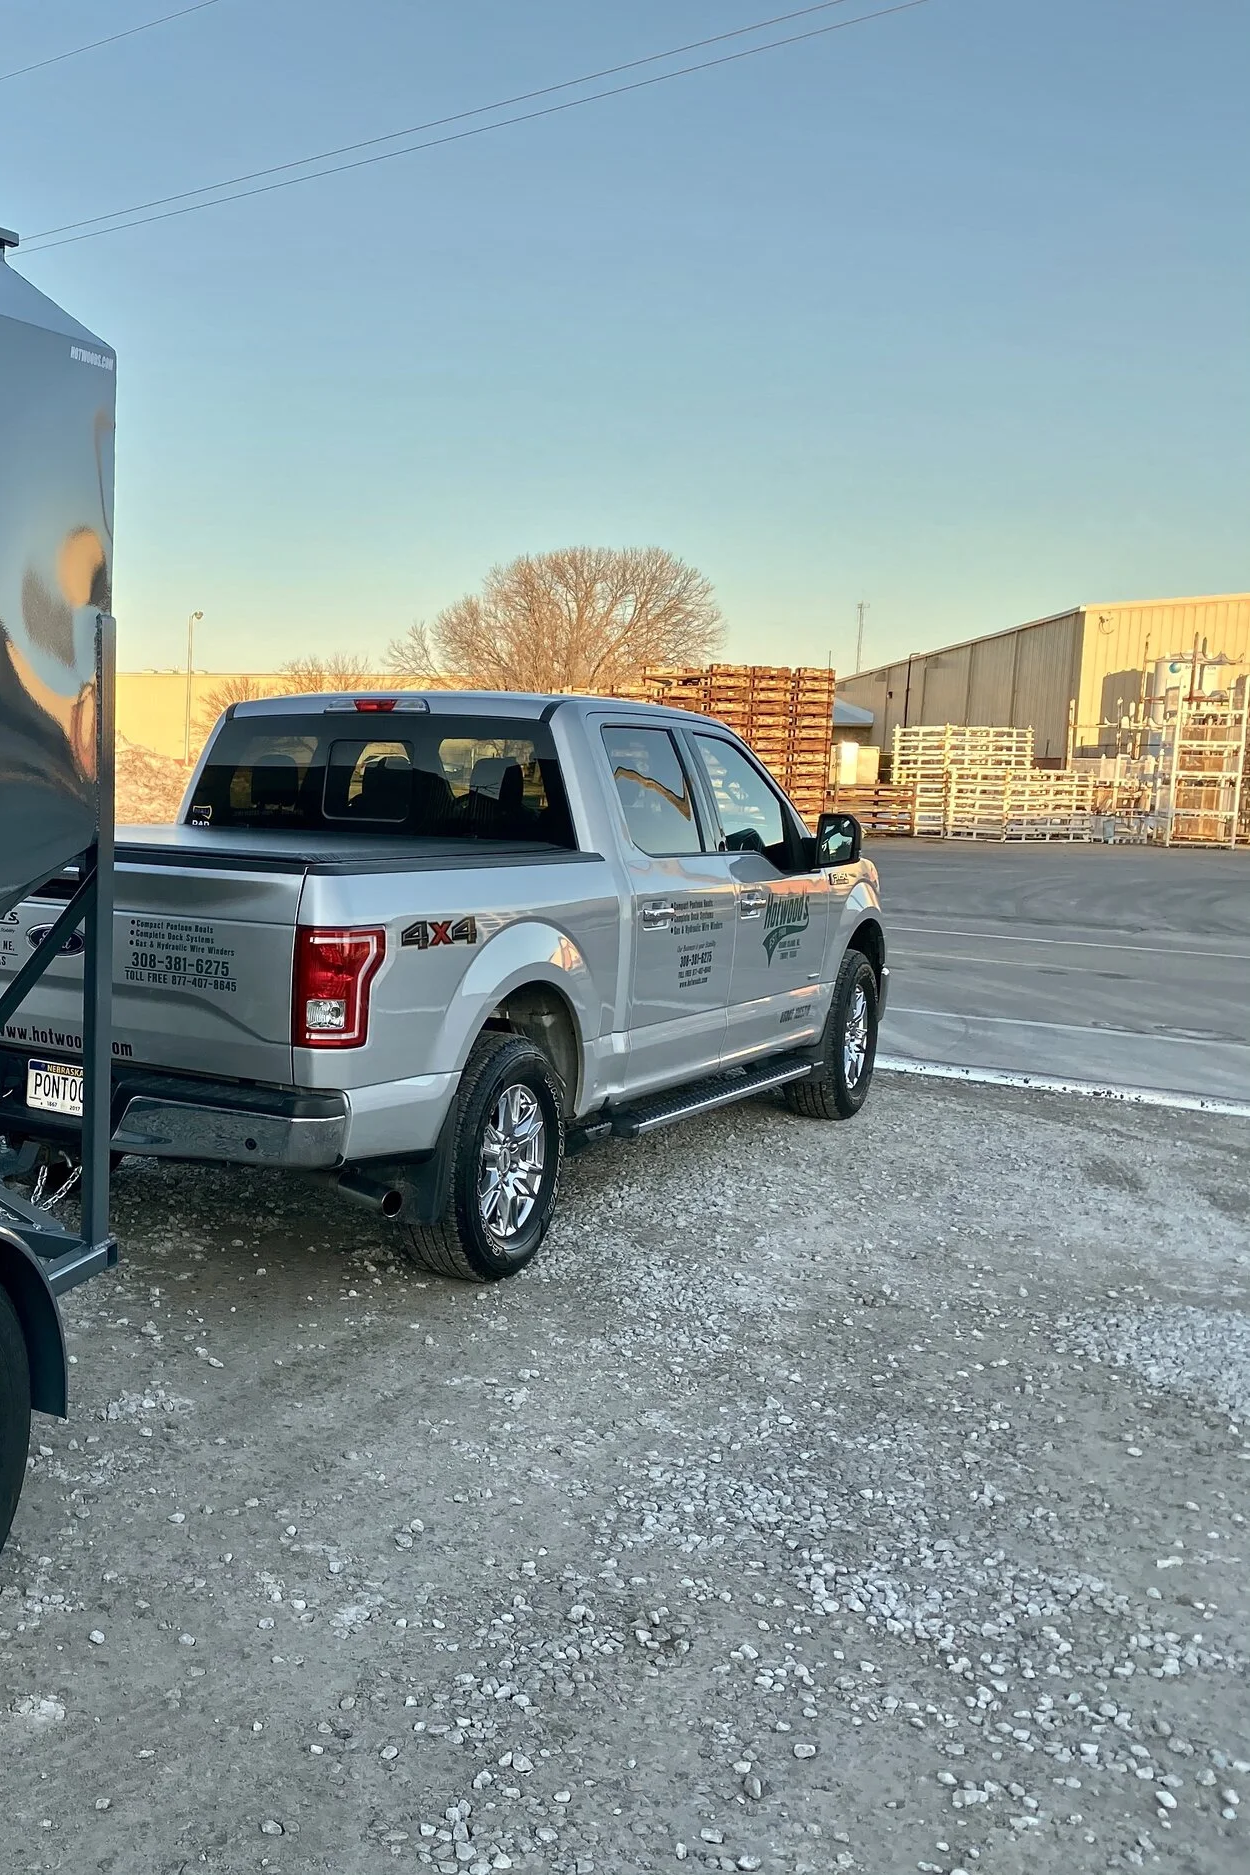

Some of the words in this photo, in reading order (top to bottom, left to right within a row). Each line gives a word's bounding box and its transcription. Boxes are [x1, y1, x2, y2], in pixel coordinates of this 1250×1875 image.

[136, 919, 164, 930] Compact
[166, 922, 192, 932] Pontoon
[194, 925, 214, 934] Boats
[135, 929, 165, 940] Complete
[167, 932, 183, 941] Dock
[185, 934, 214, 944] Systems
[135, 939, 147, 947] Gas
[149, 940, 154, 948] &
[156, 941, 187, 952] Hydraulic
[190, 945, 205, 954] Wire
[207, 946, 235, 957] Winders
[131, 951, 230, 977] 308-381-6275
[125, 969, 145, 981] TOLL
[147, 972, 168, 984] FREE
[171, 974, 237, 992] 877-407-8645
[46, 1063, 84, 1077] NEBRASKA
